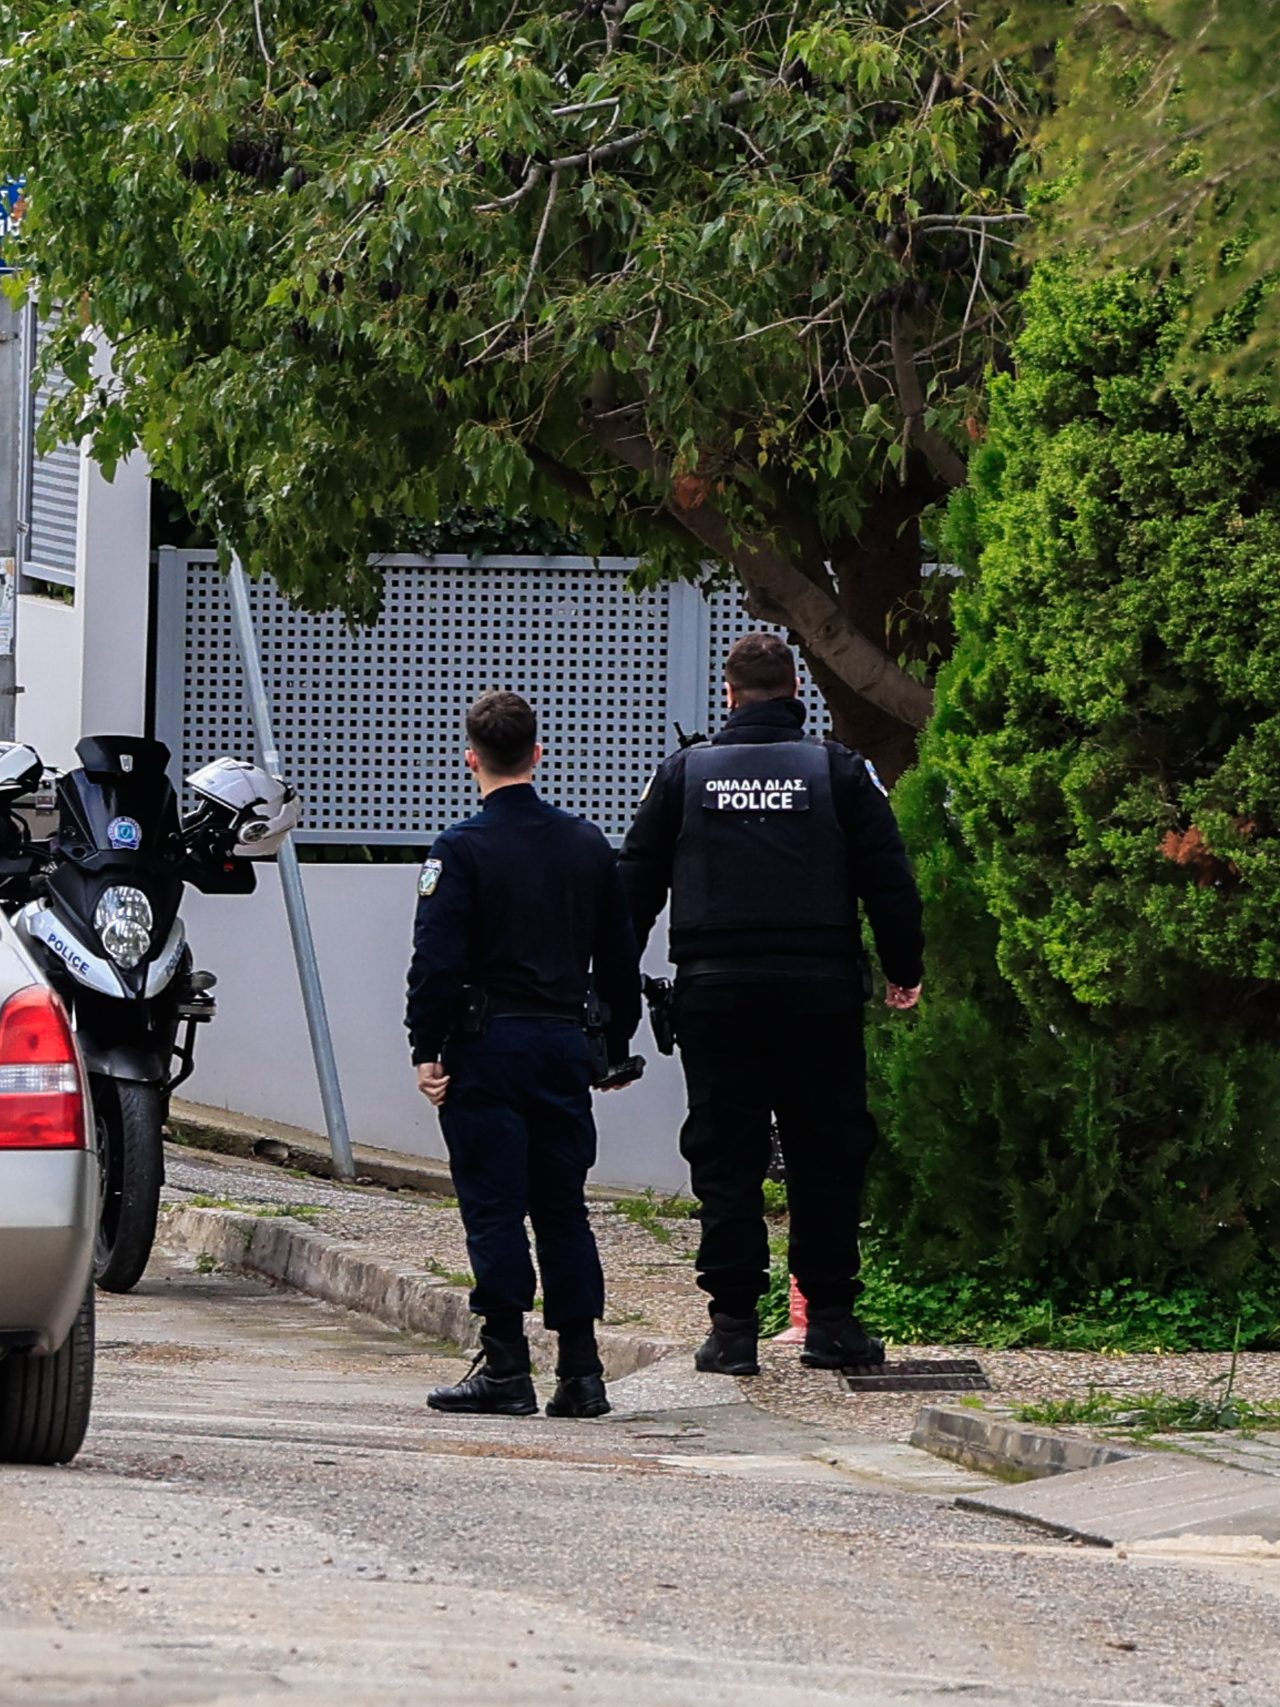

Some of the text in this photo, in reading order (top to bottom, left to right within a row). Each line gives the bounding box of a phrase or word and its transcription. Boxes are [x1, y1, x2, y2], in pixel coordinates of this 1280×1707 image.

[706, 779, 807, 791] ΟΜΑΔΑ ΔΙ.ΑΣ.
[717, 792, 793, 810] POLICE
[48, 933, 90, 975] POLICE
